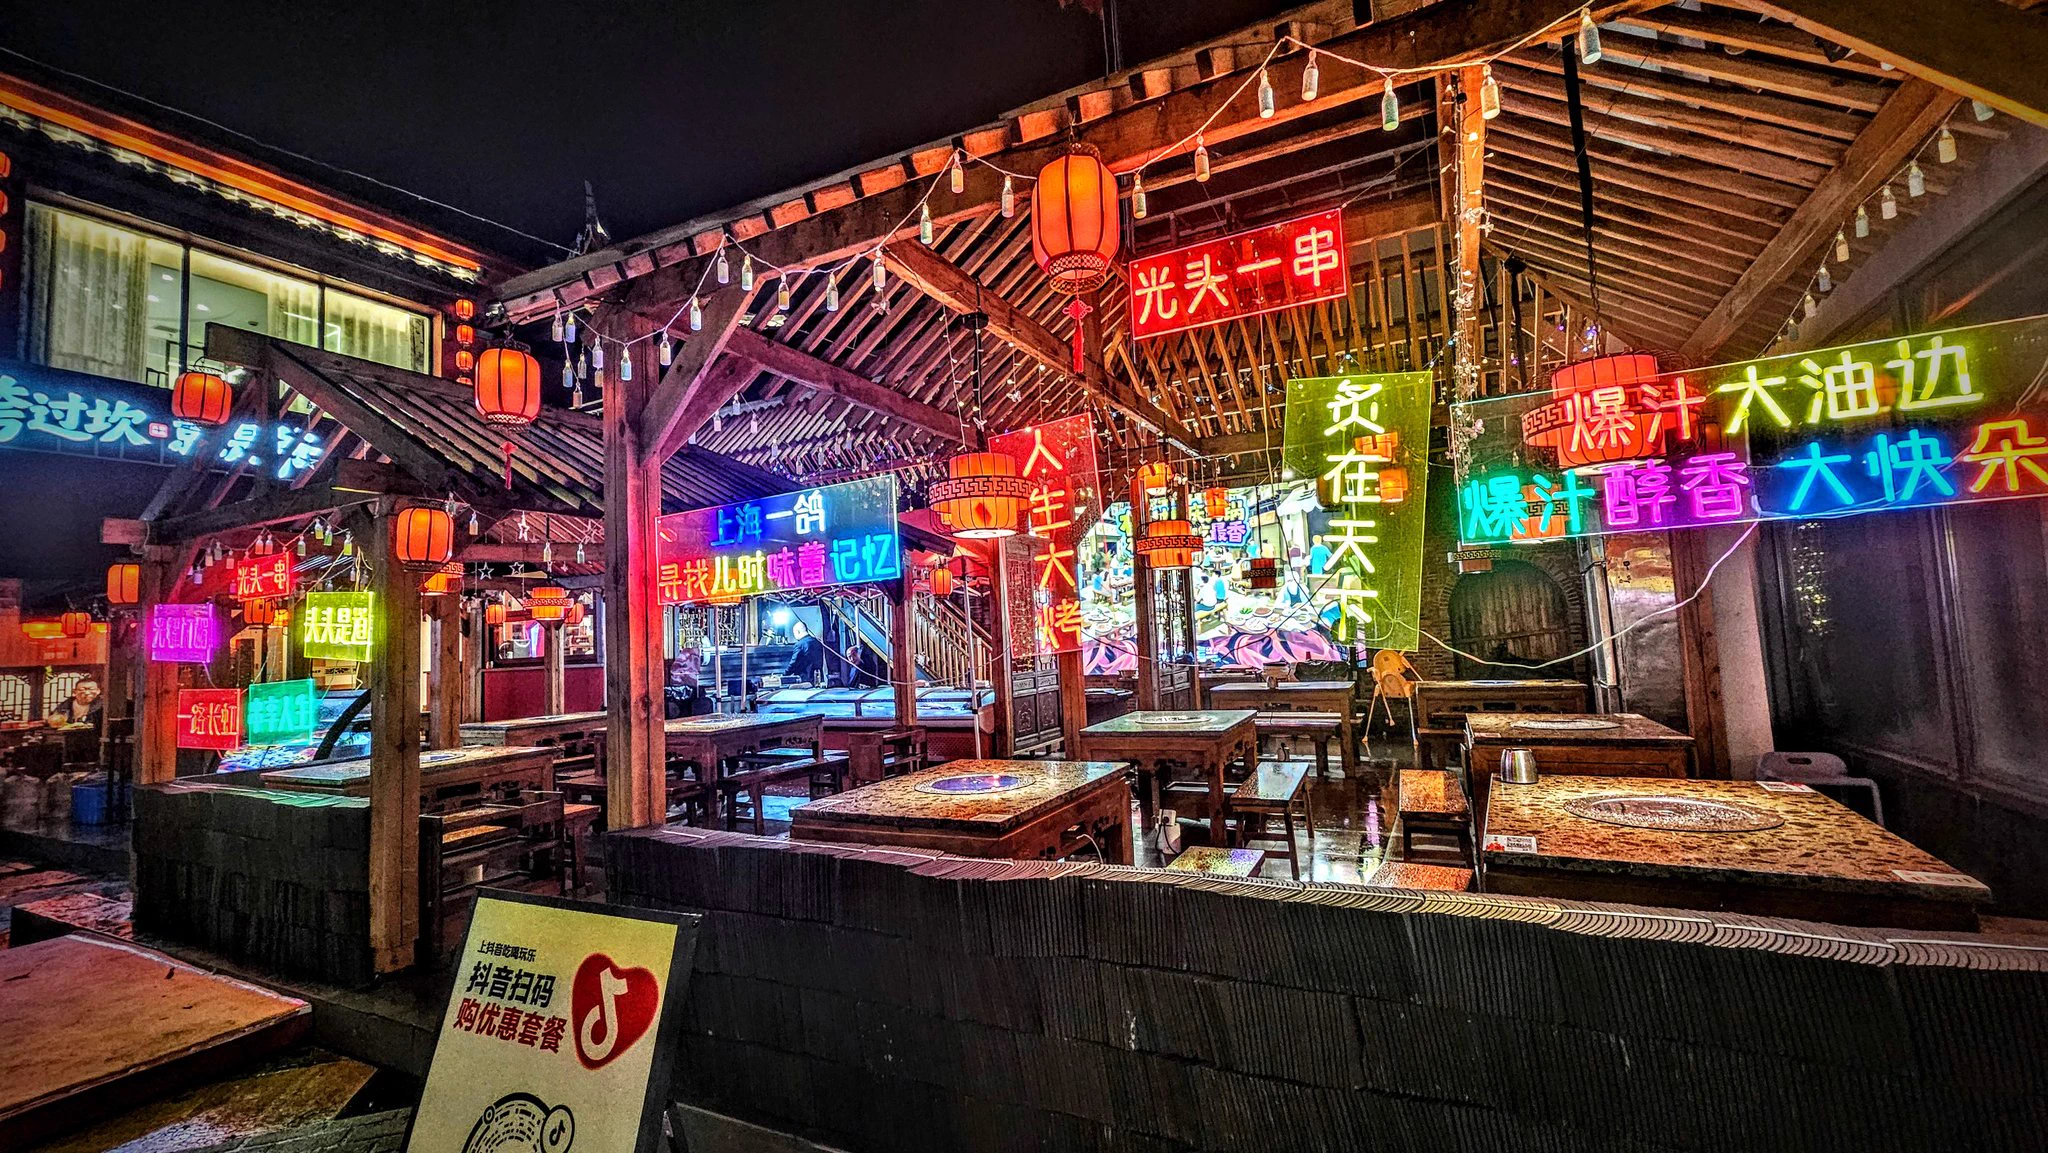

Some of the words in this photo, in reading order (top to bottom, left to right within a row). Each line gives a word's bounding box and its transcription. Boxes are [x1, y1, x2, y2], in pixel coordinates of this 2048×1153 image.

[1135, 227, 1339, 325] 光头一串
[1565, 335, 1985, 452] 爆汁大油边
[710, 489, 826, 547] 上海一鸽
[1022, 428, 1083, 650] 人生大烤
[1317, 379, 1386, 642] 炙在天下
[237, 560, 288, 596] 光头一串
[658, 533, 897, 601] 寻找儿时味蕾记忆
[304, 606, 371, 646] 头头是道
[177, 702, 239, 737] 一路长虹
[477, 940, 537, 962] 上抖音吃喝玩乐
[465, 960, 557, 1009] 抖音扫码
[452, 997, 568, 1054] 购优惠套餐
